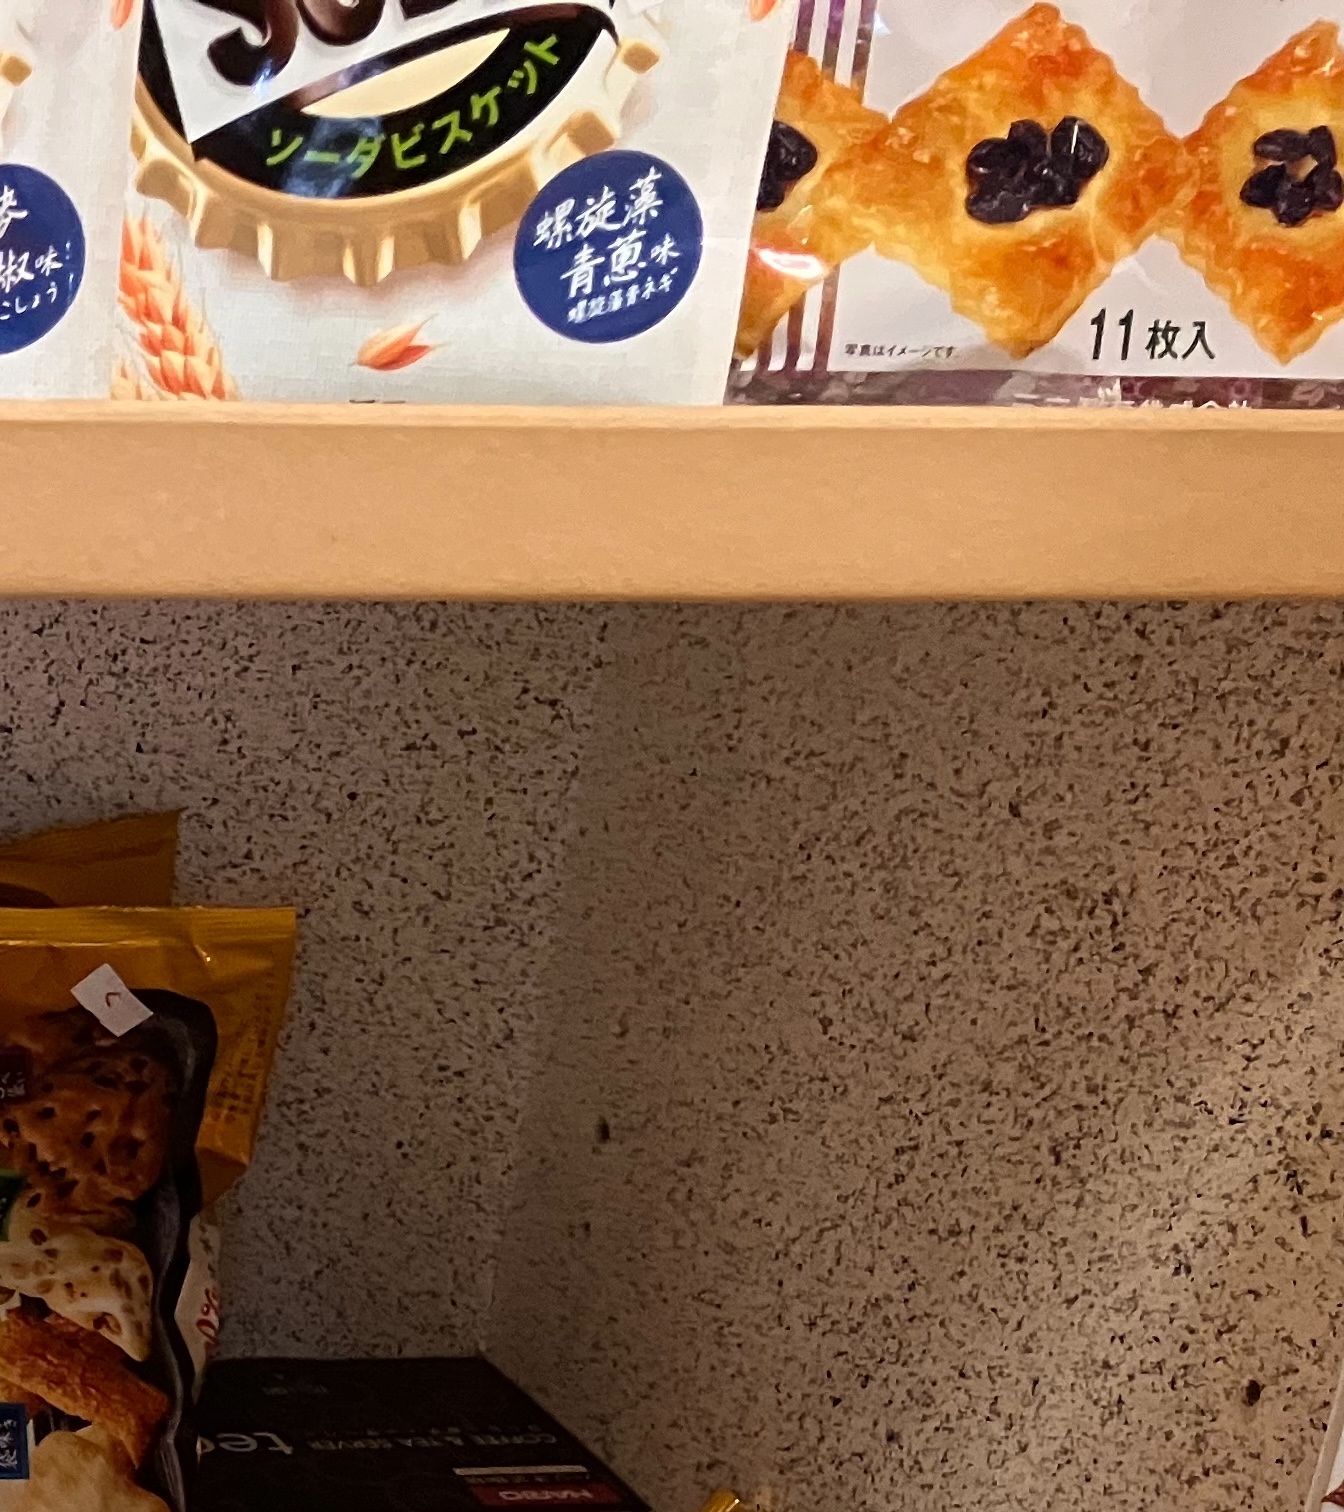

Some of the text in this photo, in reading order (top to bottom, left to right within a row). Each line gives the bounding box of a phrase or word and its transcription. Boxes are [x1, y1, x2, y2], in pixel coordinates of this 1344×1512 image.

[265, 33, 561, 178] ソーダビスケット
[1089, 306, 1217, 363] 11枚入
